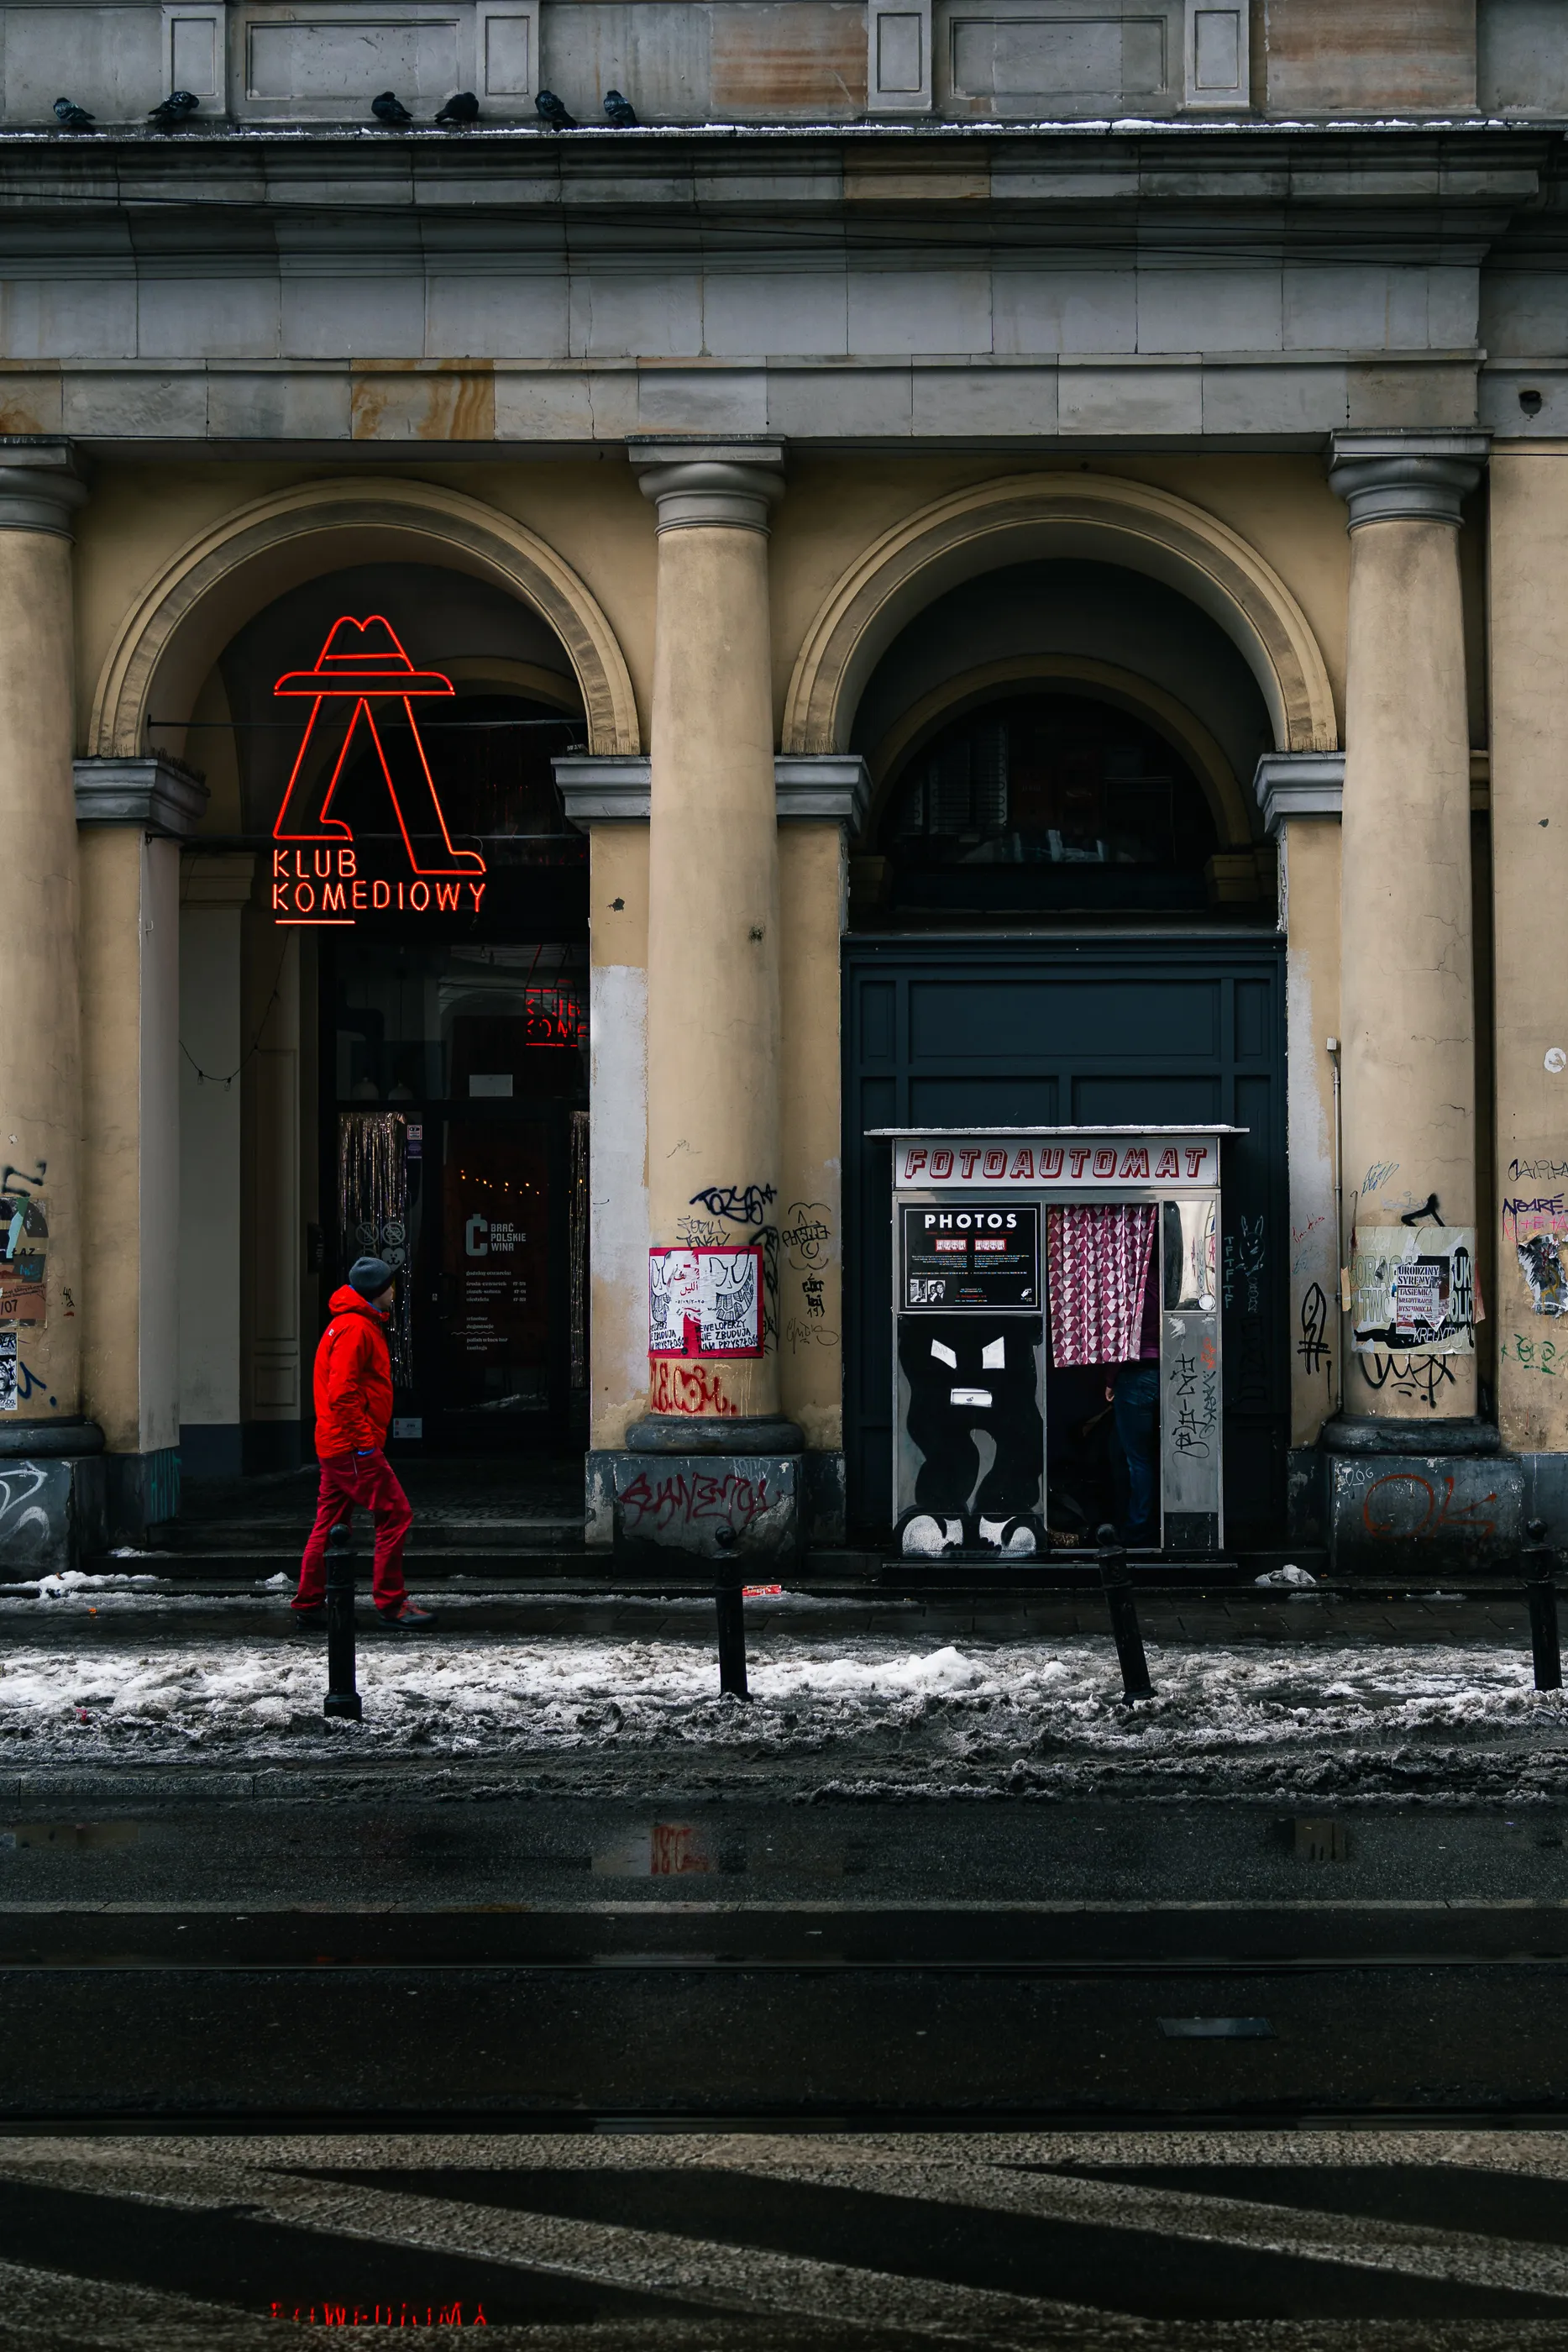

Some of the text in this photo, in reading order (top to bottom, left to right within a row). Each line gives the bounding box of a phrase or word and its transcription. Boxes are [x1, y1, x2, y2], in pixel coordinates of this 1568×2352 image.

[274, 849, 357, 878] KLUB
[273, 880, 486, 912] KOMEDIOWY
[905, 1147, 1208, 1179] FOTOAUTOMAT
[925, 1213, 1017, 1229] PHOTOS
[490, 1232, 527, 1242] POLSKIE
[490, 1242, 514, 1252] WINA
